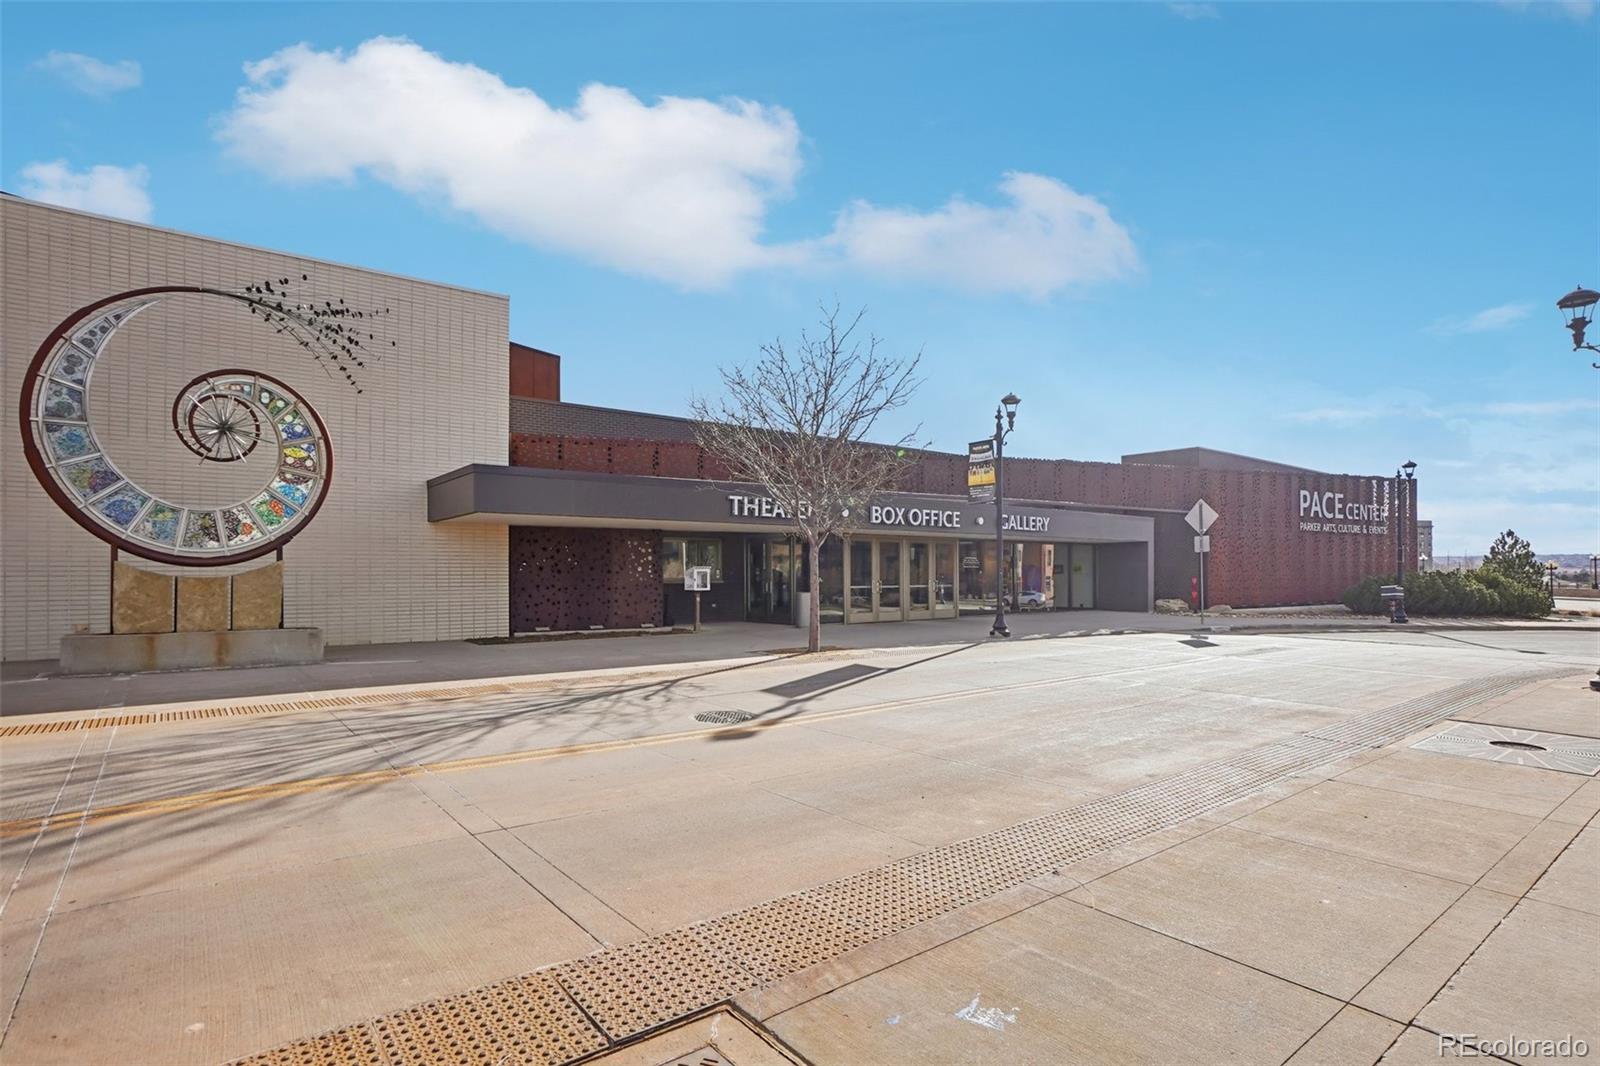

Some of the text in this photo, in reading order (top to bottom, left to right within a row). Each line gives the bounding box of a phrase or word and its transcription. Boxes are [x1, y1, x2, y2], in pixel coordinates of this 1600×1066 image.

[871, 505, 961, 528] BOX OFFICE
[1299, 489, 1387, 522] PACE CENTER
[1299, 522, 1321, 532] PARKER
[1338, 524, 1361, 534] CULTURE
